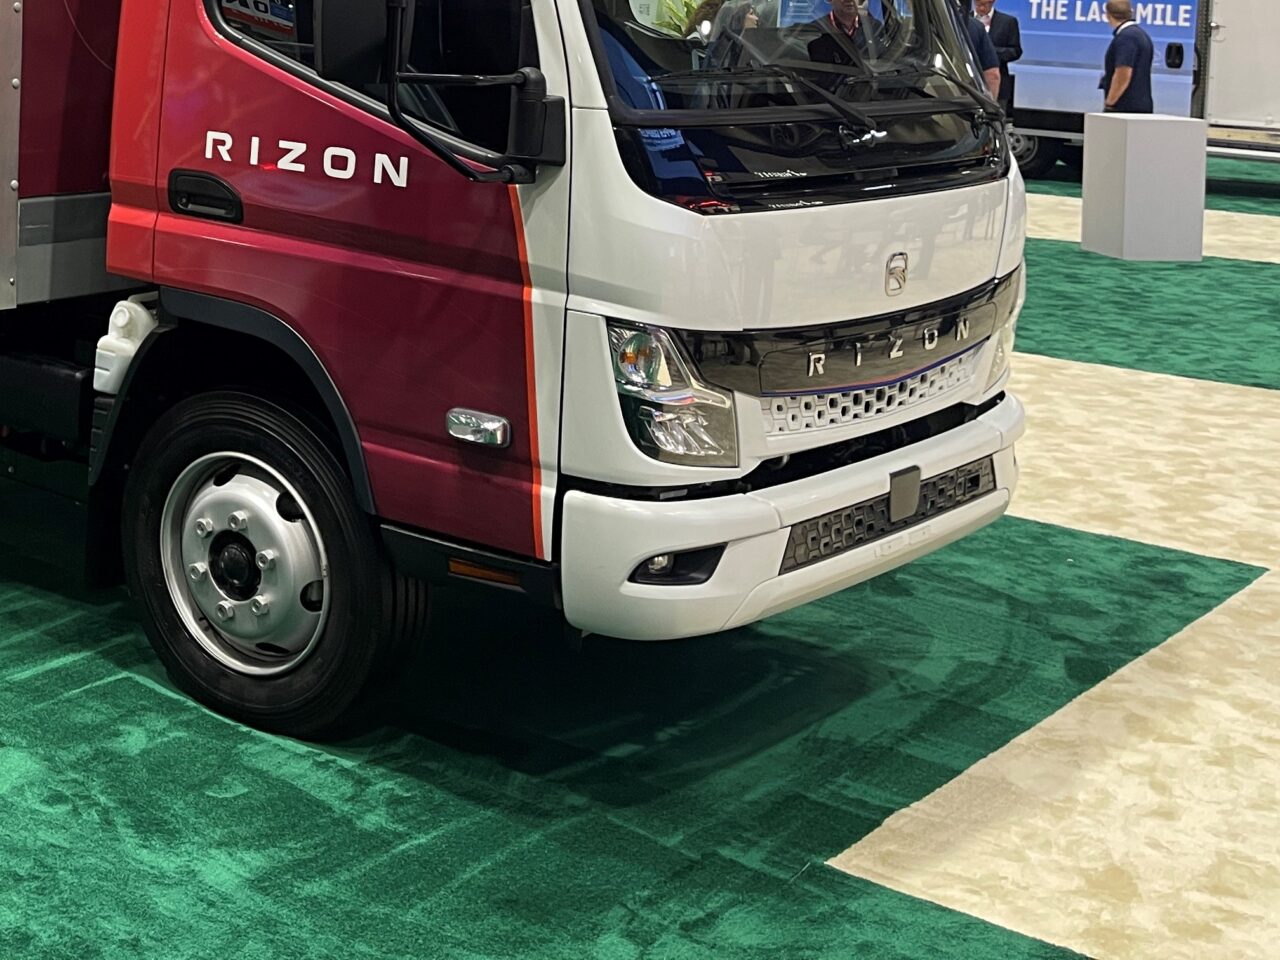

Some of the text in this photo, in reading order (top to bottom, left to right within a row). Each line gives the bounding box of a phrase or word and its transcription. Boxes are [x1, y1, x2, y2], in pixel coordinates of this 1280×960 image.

[1075, 0, 1109, 23] LA
[1135, 3, 1193, 27] MILE
[205, 130, 409, 188] RIZON
[808, 319, 970, 377] RIZON
